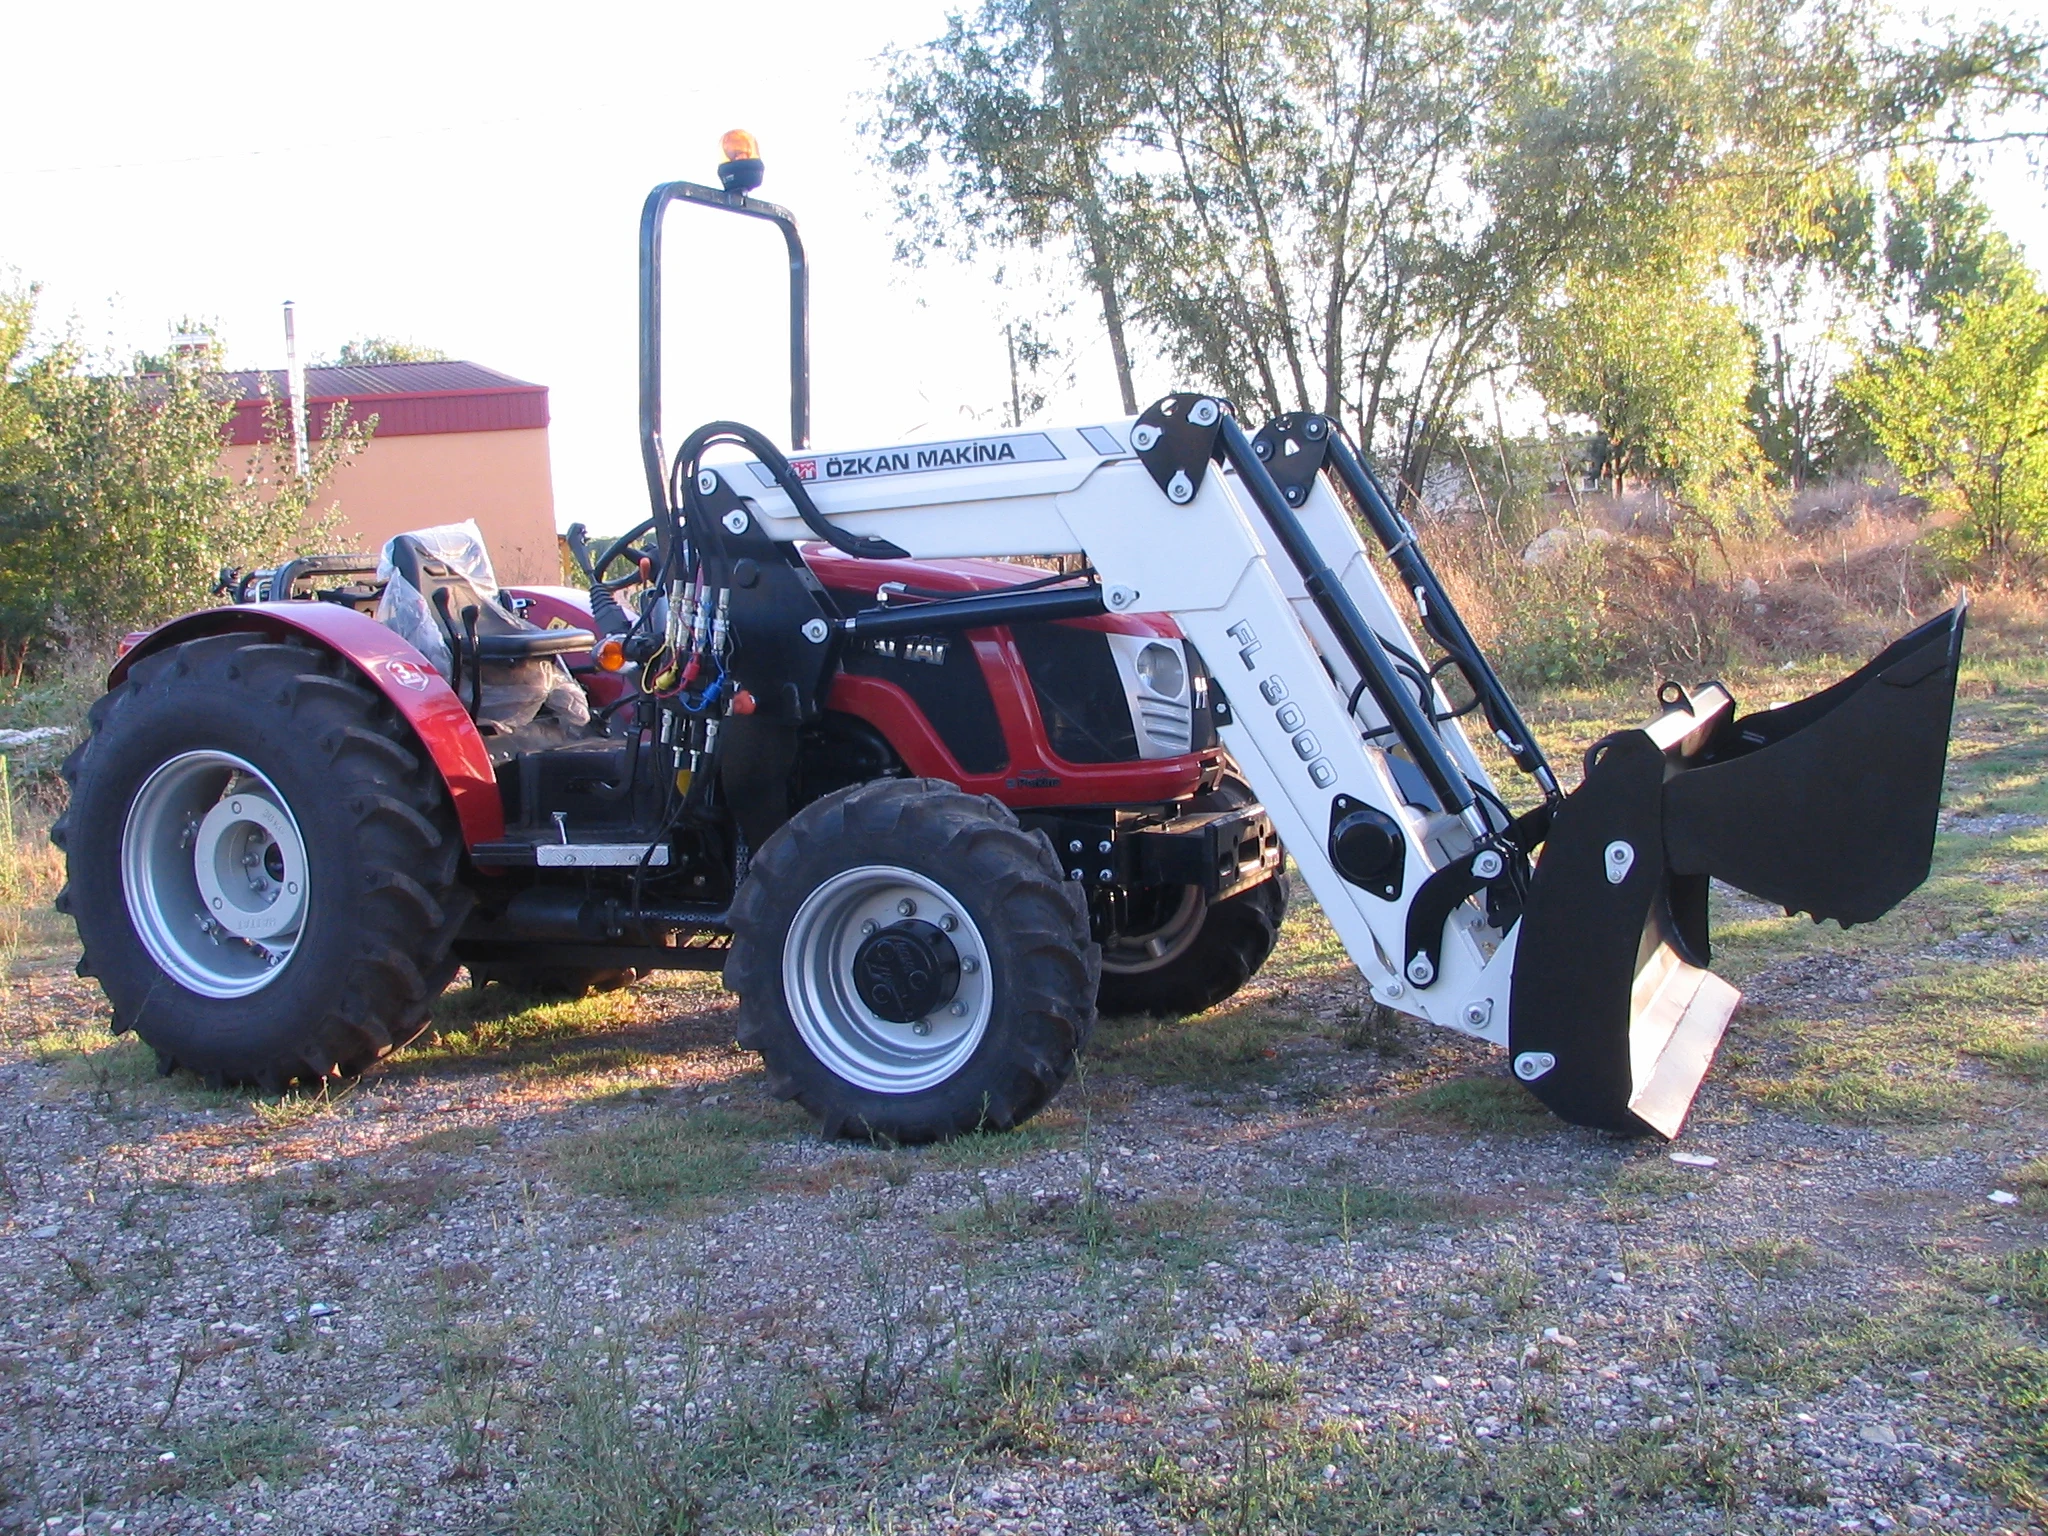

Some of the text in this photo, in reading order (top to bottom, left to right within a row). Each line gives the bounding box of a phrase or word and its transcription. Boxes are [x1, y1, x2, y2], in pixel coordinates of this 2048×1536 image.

[826, 453, 910, 478] ÖZKAN
[917, 442, 1016, 468] MAKİNA
[1226, 618, 1338, 790] FL 3000
